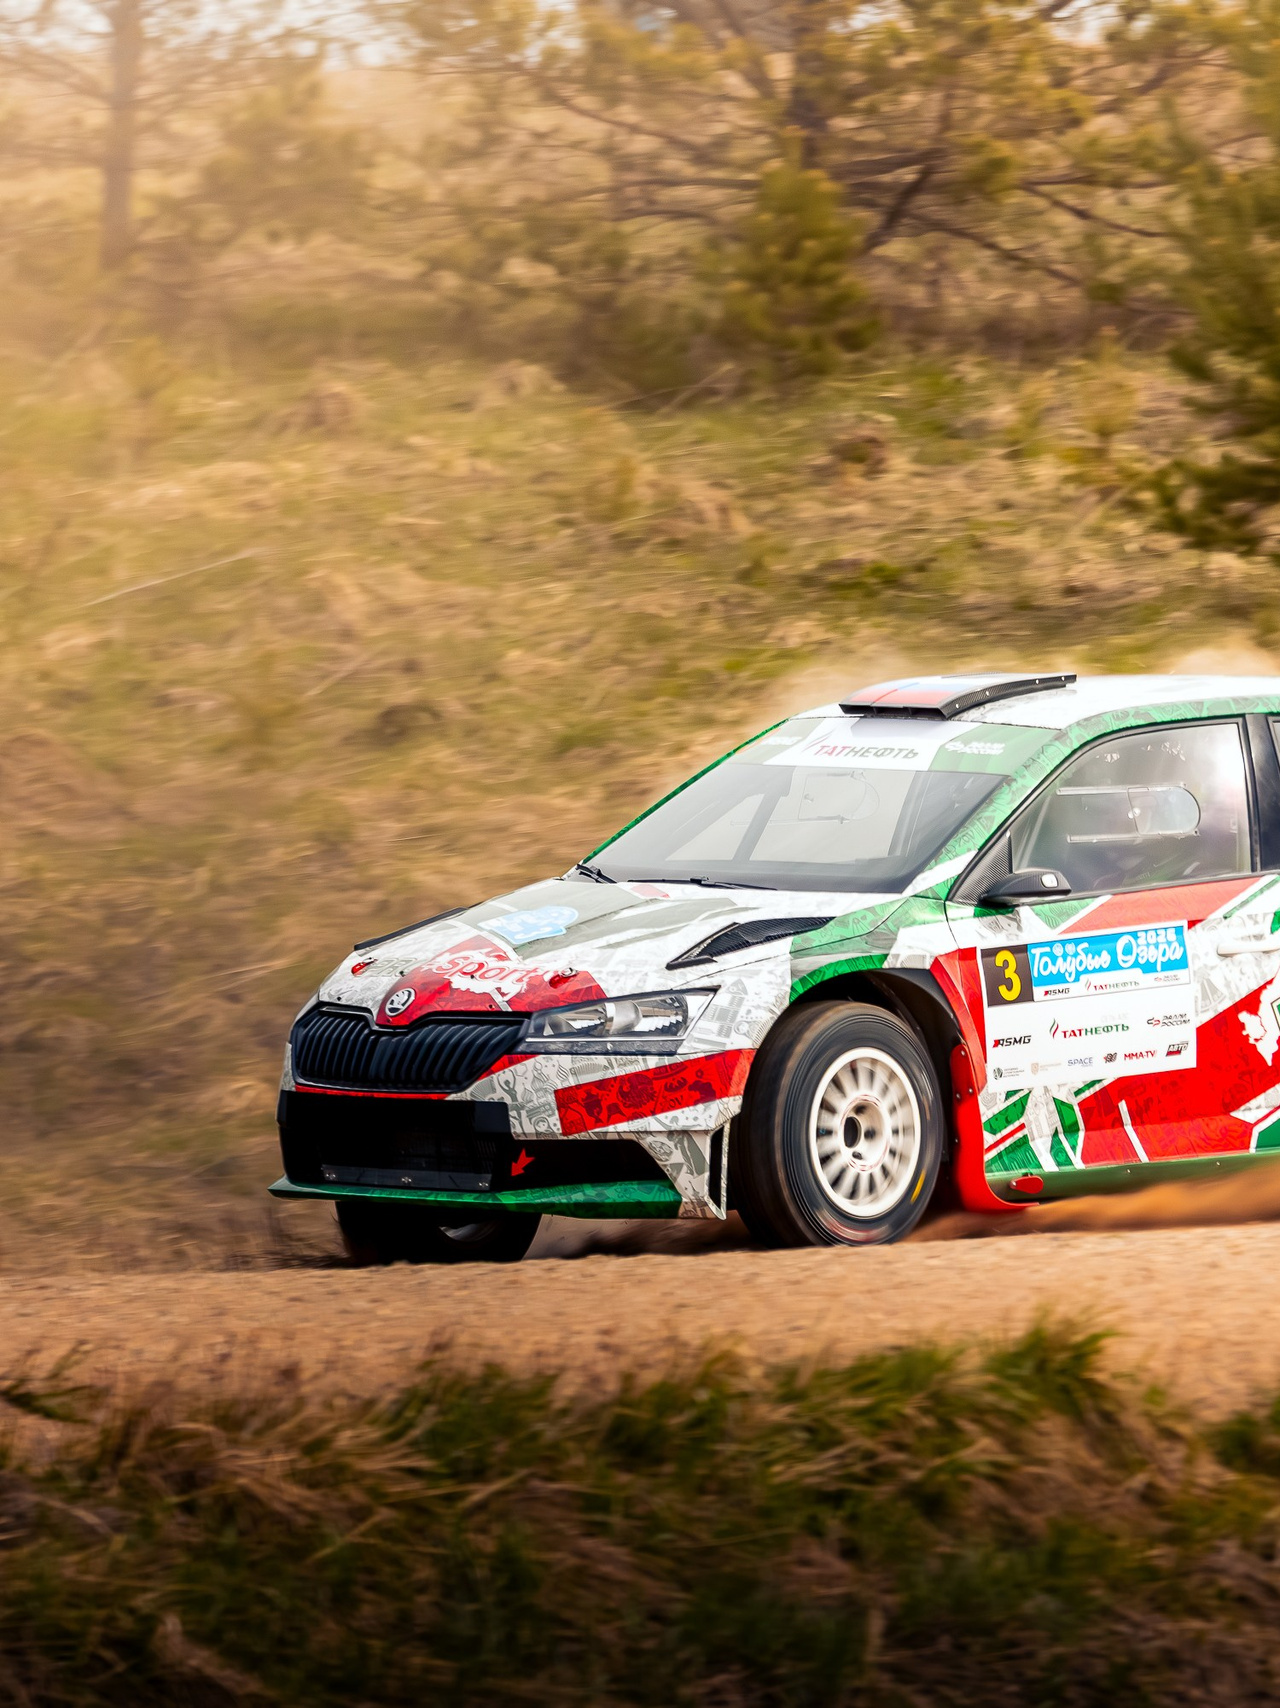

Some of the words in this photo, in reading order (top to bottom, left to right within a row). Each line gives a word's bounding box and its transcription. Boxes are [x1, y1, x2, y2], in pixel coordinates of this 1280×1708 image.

[814, 745, 919, 759] ТАТНЕФТЬ
[995, 949, 1022, 1001] 3
[1093, 980, 1140, 991] ТАТНЕФТЬ
[1061, 1023, 1130, 1039] ТАТНЕФТЬ
